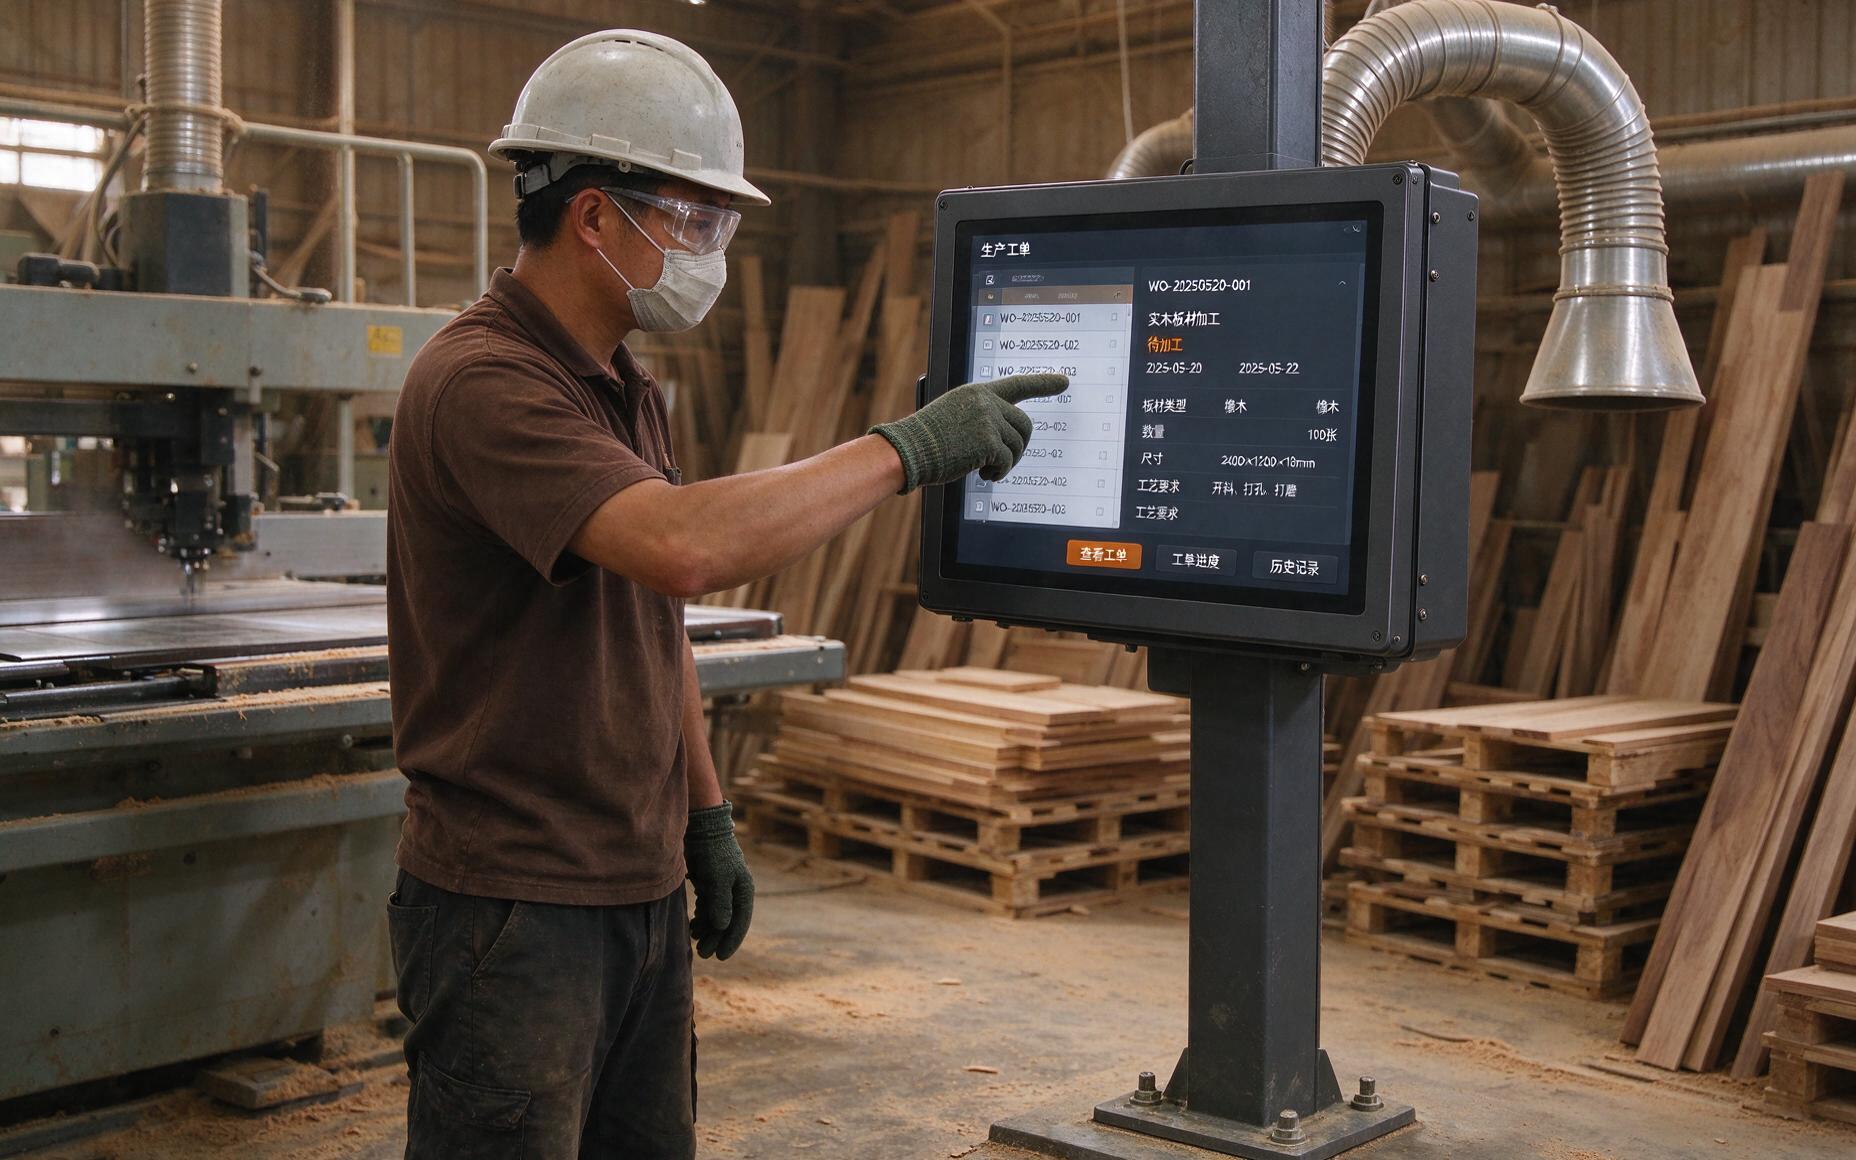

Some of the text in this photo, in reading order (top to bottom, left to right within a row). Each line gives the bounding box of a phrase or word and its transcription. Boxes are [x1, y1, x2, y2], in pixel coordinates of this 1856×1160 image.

[980, 241, 1031, 258] 生产工单
[1148, 279, 1251, 292] WO-20250520-001
[1148, 310, 1221, 327] 实木板材加工
[1147, 335, 1184, 353] 待加工
[1238, 361, 1300, 375] 2025-05-22
[1142, 398, 1187, 414] 板材类型
[1142, 424, 1338, 442] 数量 100张
[1141, 451, 1164, 465] 尺寸
[1137, 478, 1180, 493] 工艺要求
[1135, 506, 1179, 520] 工艺要求
[1080, 546, 1128, 563] 查看工单
[1172, 552, 1220, 570] 工单进度
[1270, 558, 1320, 576] 历史记录
